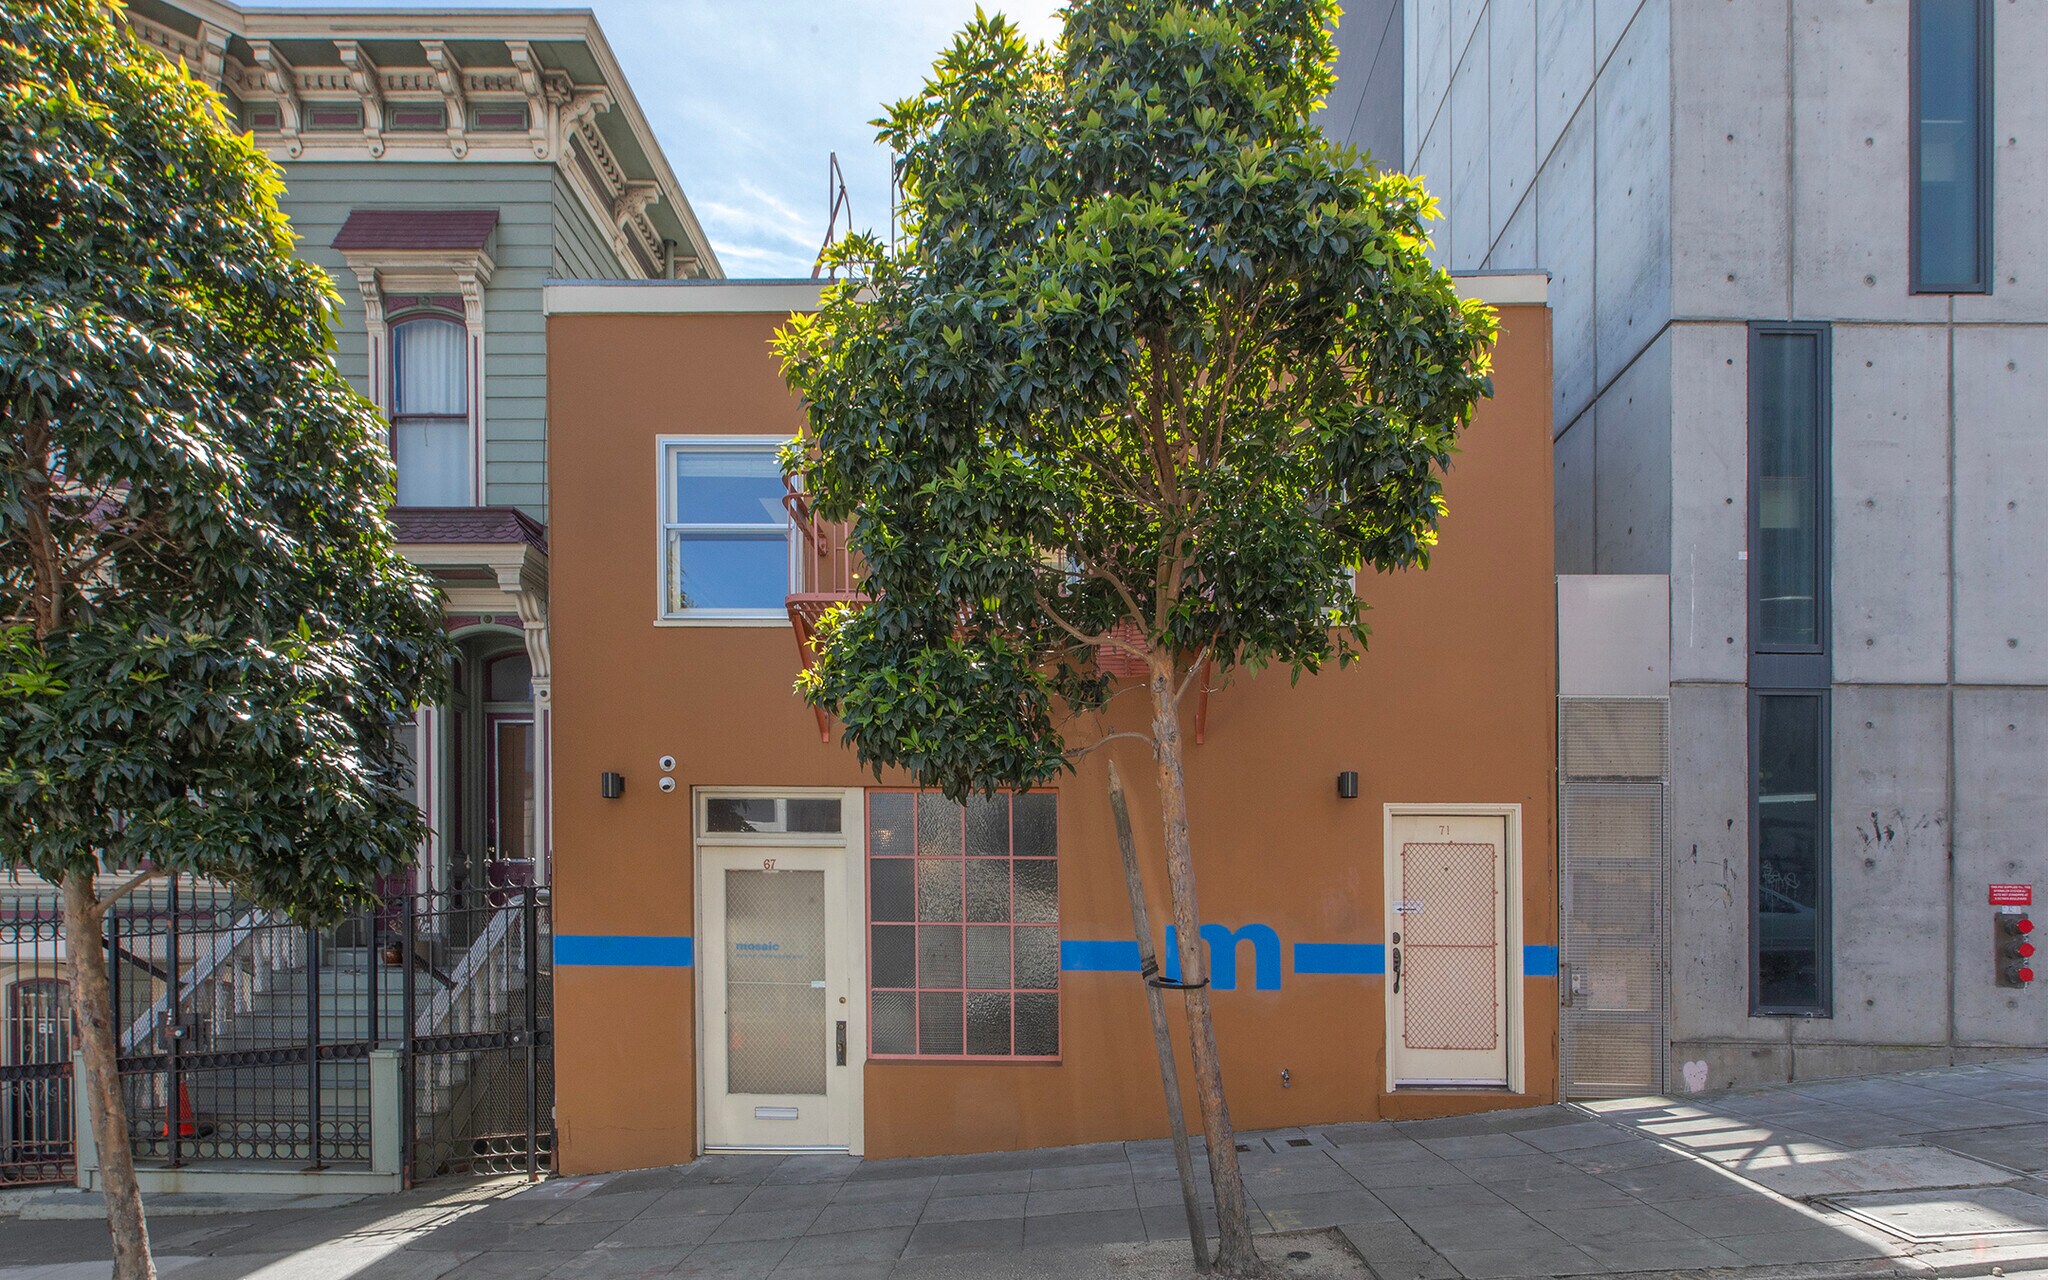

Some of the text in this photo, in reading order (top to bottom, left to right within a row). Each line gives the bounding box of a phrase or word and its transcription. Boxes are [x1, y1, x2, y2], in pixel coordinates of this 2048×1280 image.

[1439, 825, 1450, 836] 71
[763, 859, 776, 870] 67
[735, 941, 780, 951] mosaic
[38, 1023, 54, 1034] 61
